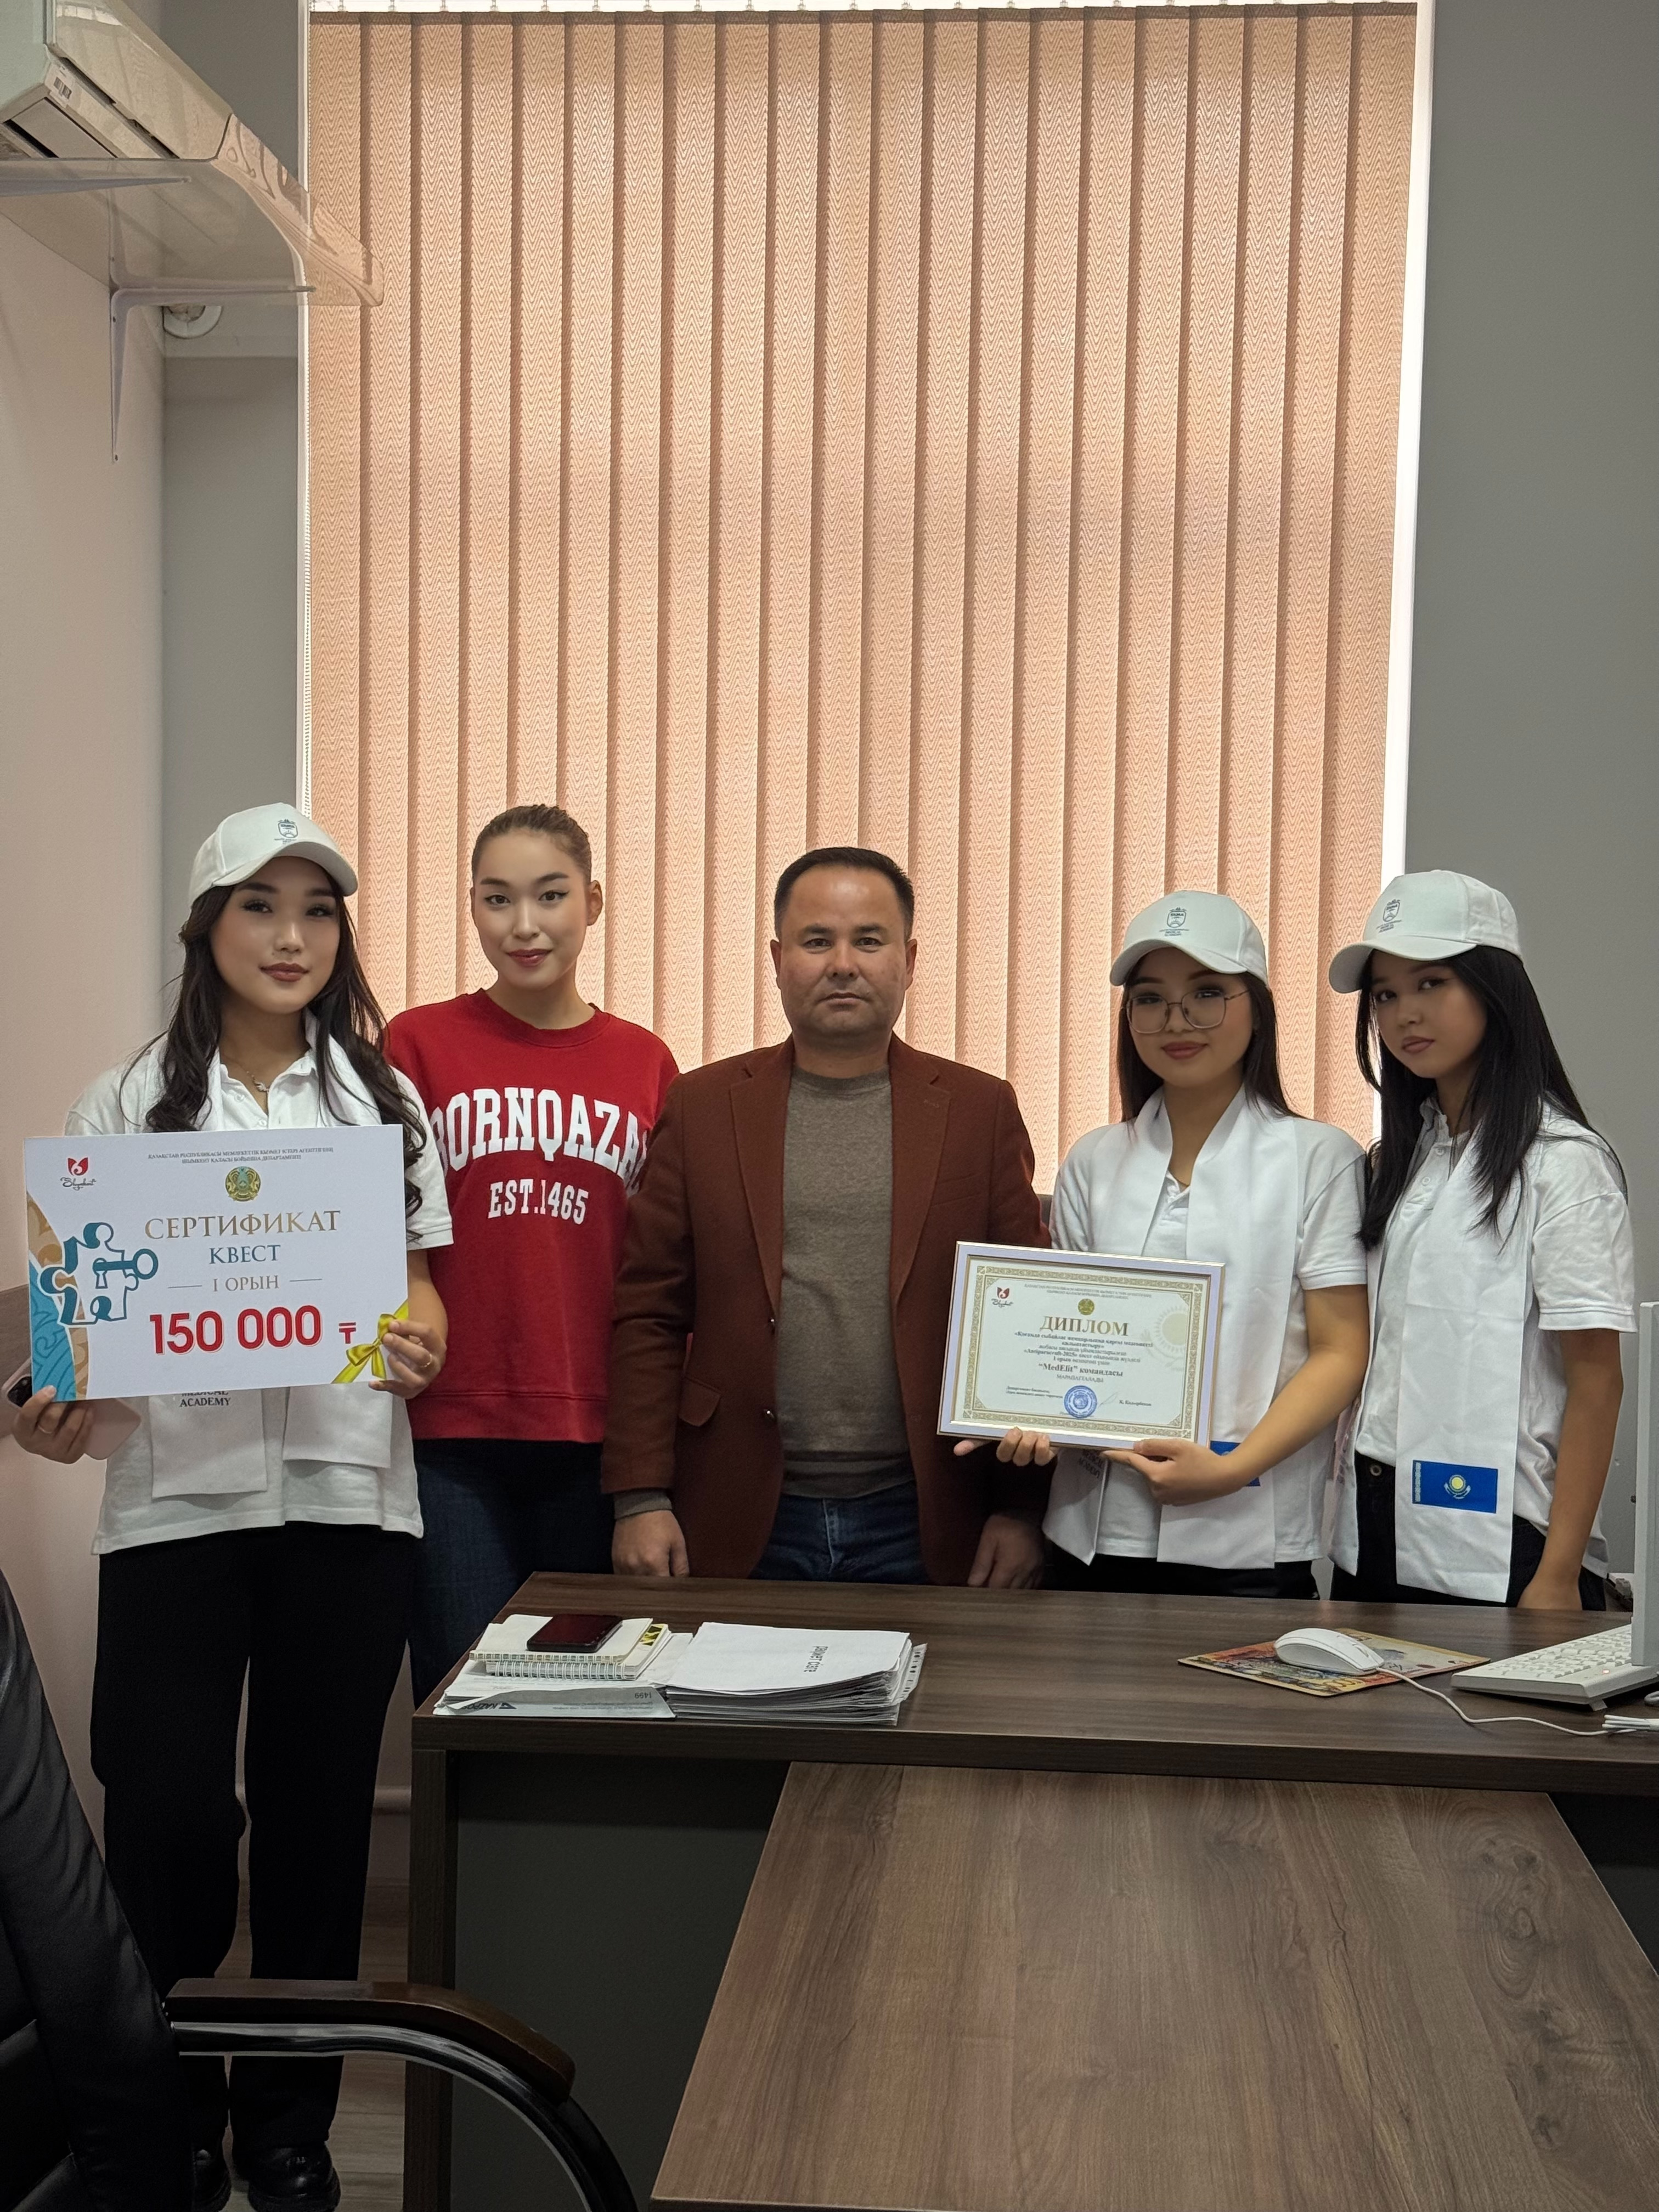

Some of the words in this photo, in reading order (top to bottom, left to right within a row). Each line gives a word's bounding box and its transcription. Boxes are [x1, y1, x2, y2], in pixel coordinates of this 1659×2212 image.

[430, 1087, 647, 1198] BORNQAZA
[488, 1179, 589, 1225] EST.1465
[145, 1210, 341, 1239] СЕРТИФИКАТ
[209, 1244, 281, 1264] КВЕСТ
[225, 1275, 279, 1291] ОРЫН
[149, 1310, 224, 1355] 150
[237, 1305, 321, 1350] 000
[1040, 1316, 1128, 1336] ДИПЛОМ
[1079, 1367, 1123, 1376] командасы
[179, 1397, 231, 1407] ACADEMY
